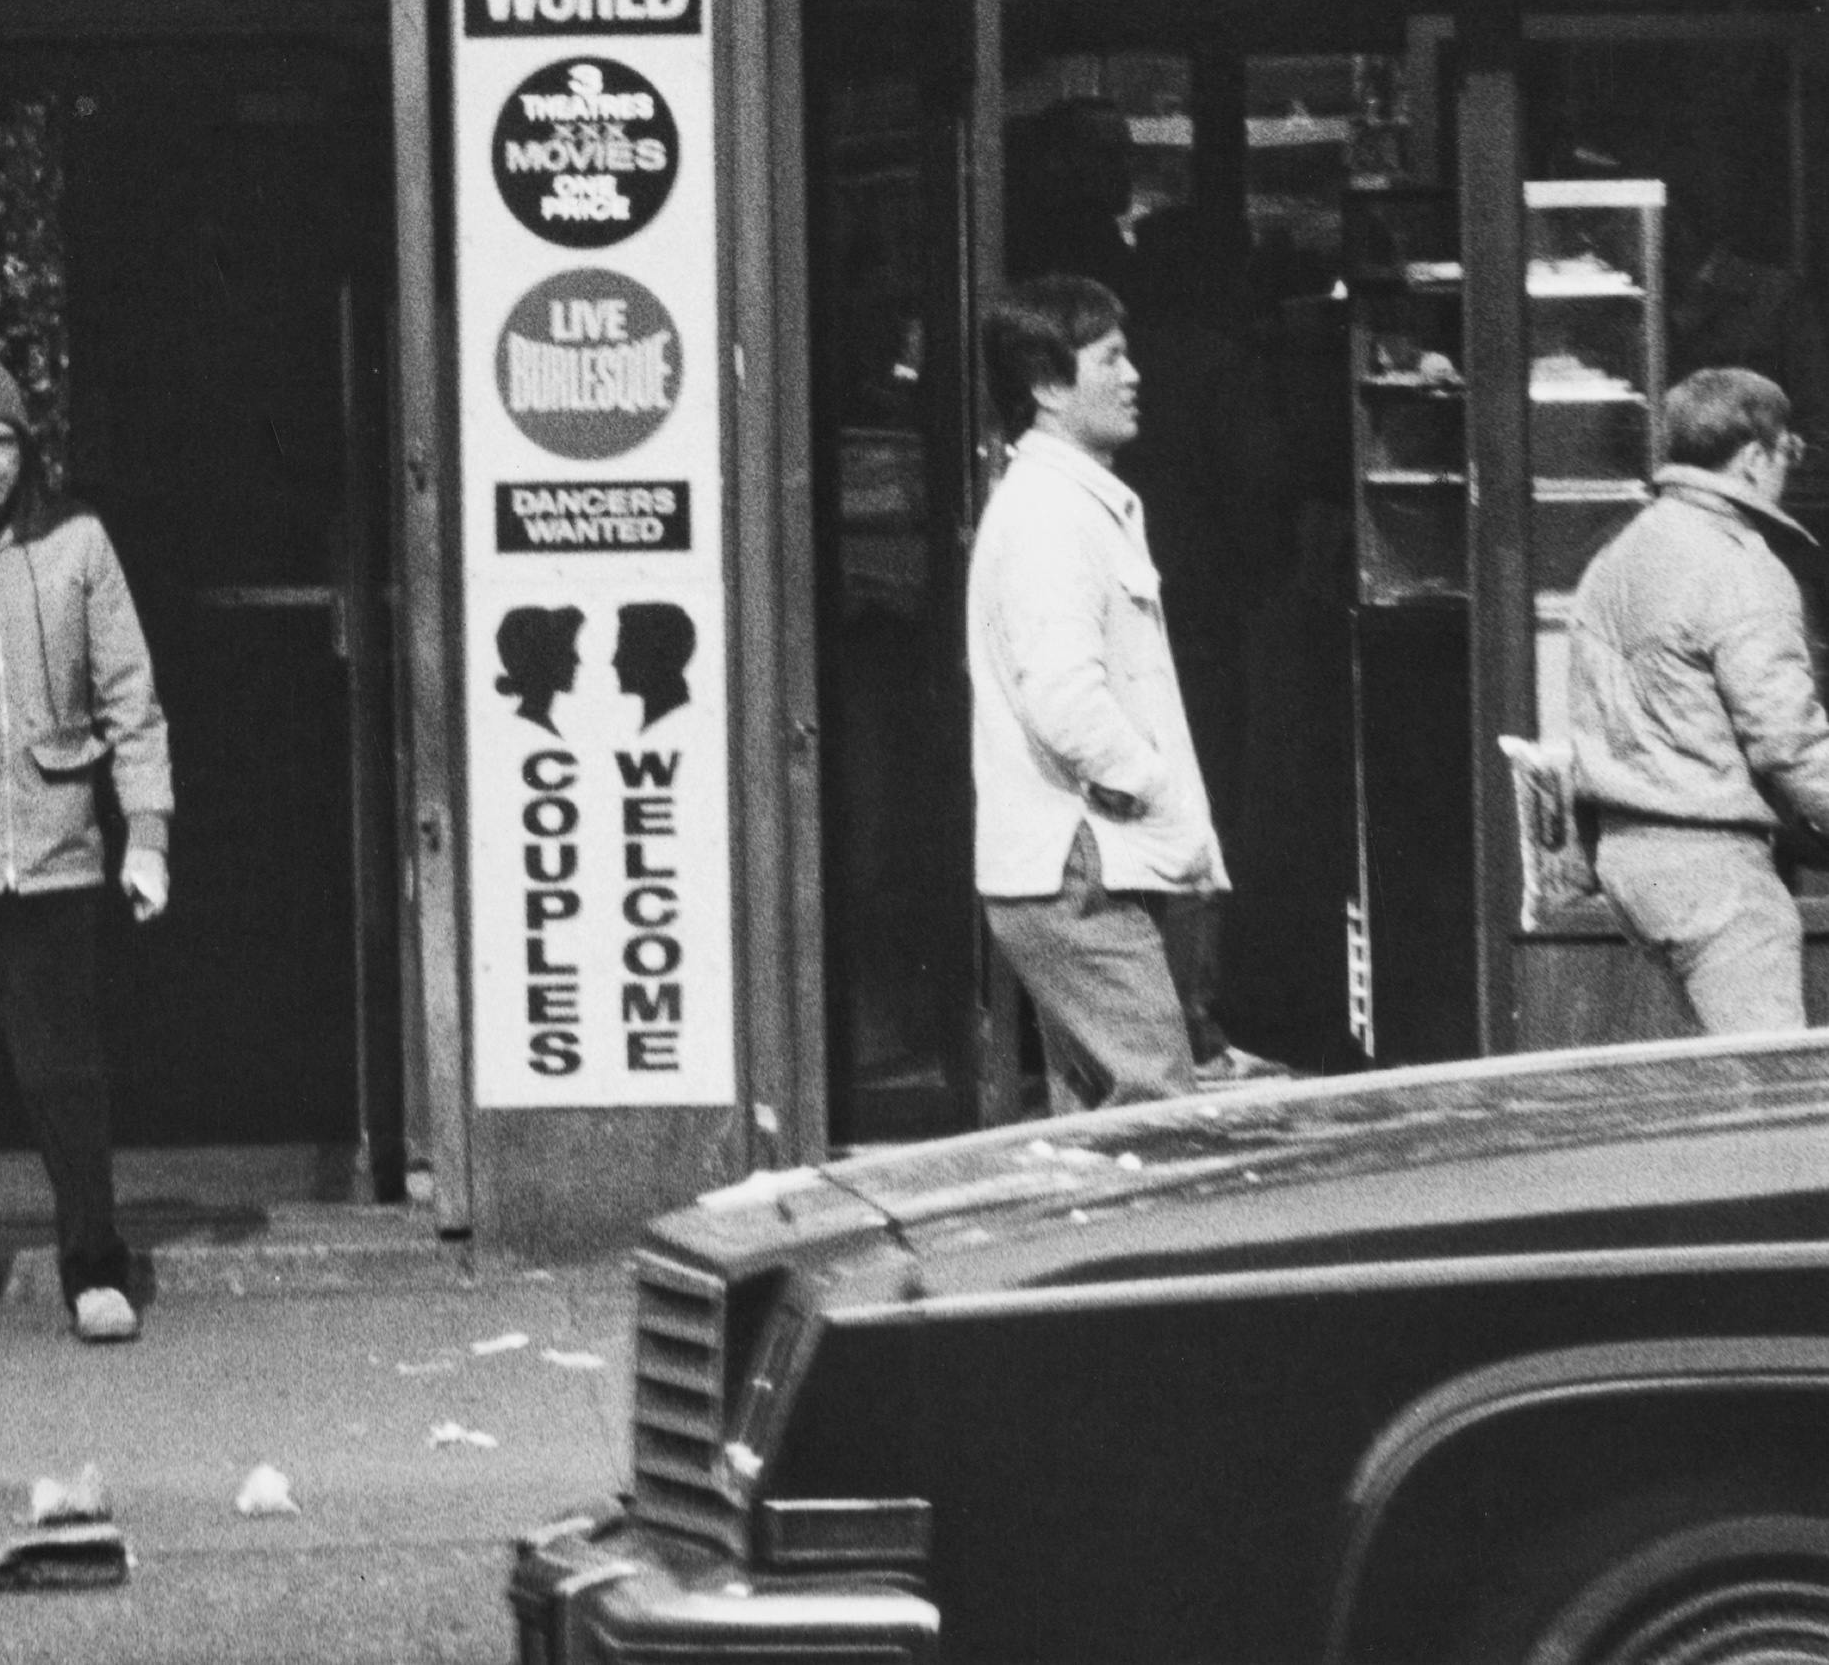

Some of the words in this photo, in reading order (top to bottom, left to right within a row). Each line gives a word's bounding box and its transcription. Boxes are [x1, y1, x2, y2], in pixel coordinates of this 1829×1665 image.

[568, 63, 604, 94] 3
[505, 135, 667, 172] MOVIES
[550, 299, 628, 342] LIVE
[507, 328, 672, 416] BURLESQUE
[512, 487, 676, 518] DANCERS
[523, 515, 664, 543] WANTED
[521, 750, 582, 1076] COUPLES
[615, 751, 682, 1071] WELCOME
